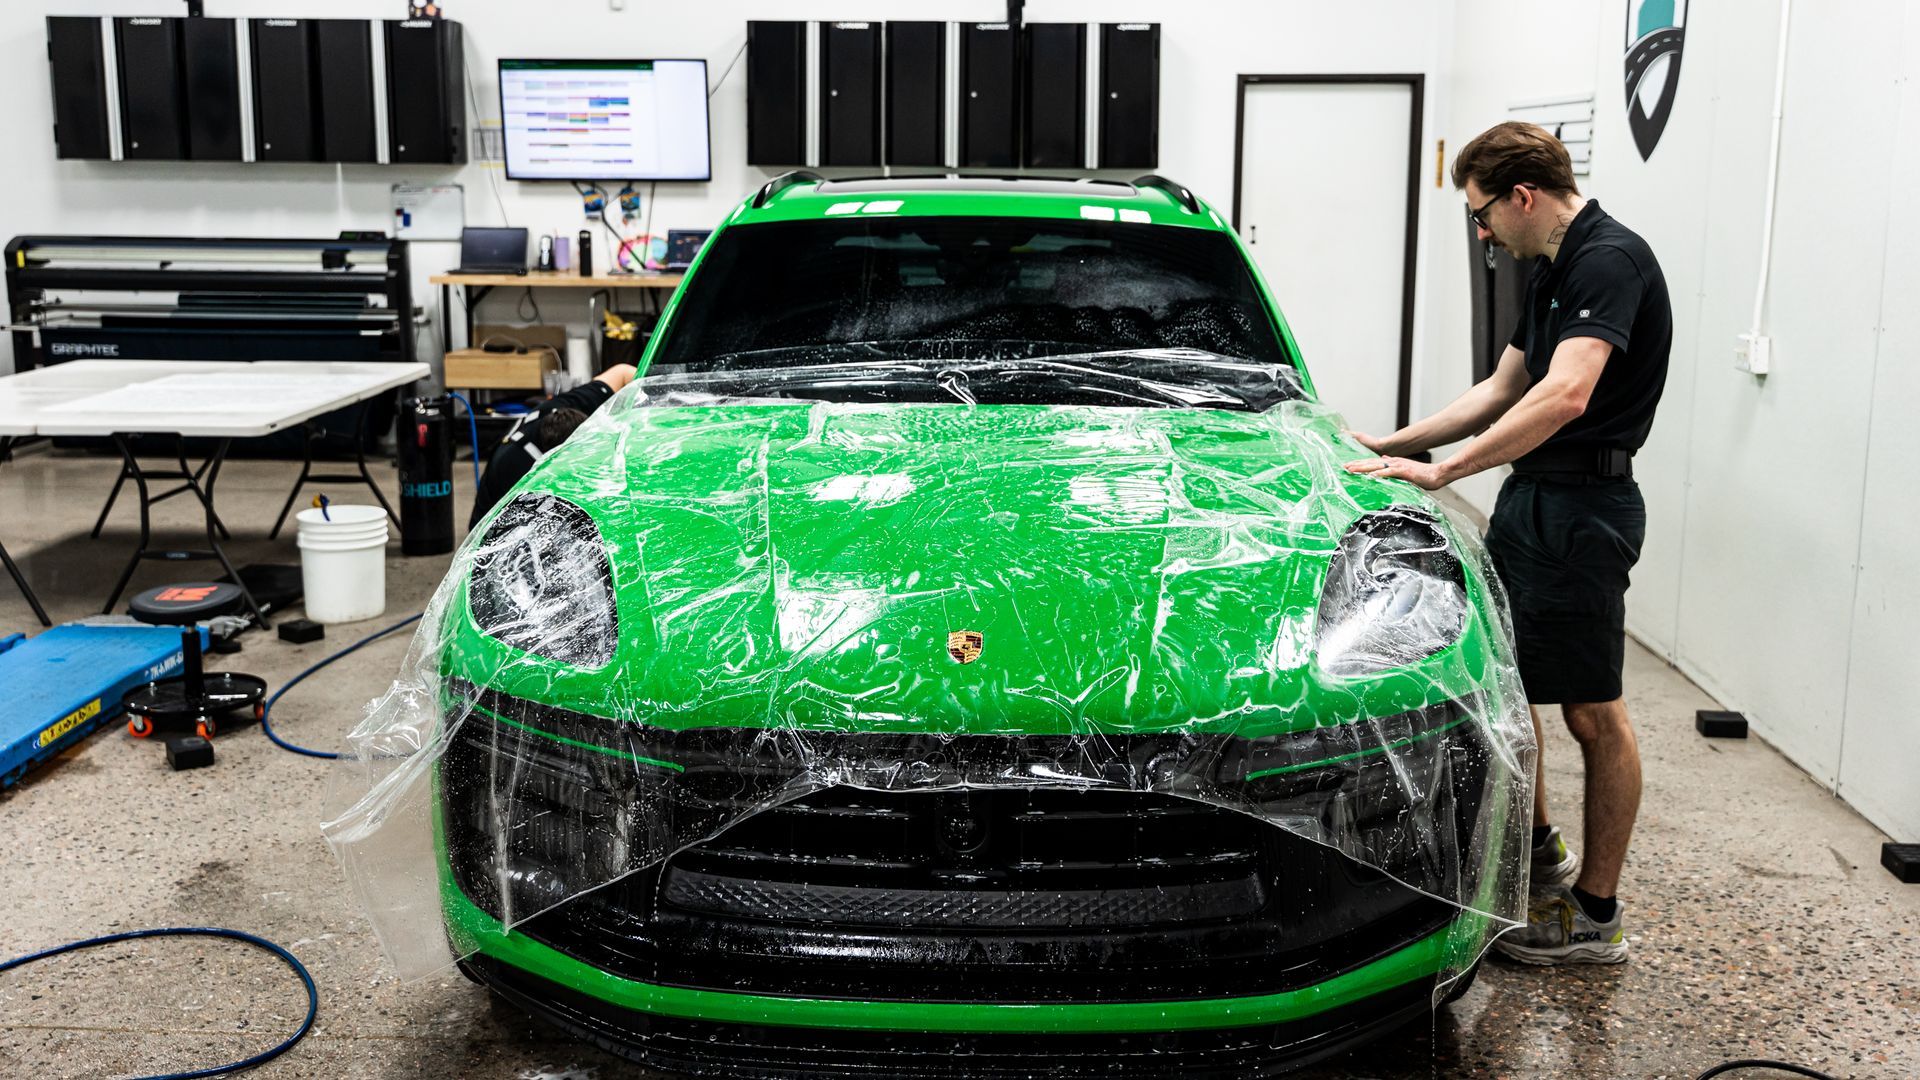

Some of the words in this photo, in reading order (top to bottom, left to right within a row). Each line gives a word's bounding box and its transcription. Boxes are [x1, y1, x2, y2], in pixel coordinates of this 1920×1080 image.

[52, 343, 119, 356] GRAPHTEC
[404, 480, 452, 498] SHIELD
[1568, 931, 1602, 945] HOKA
